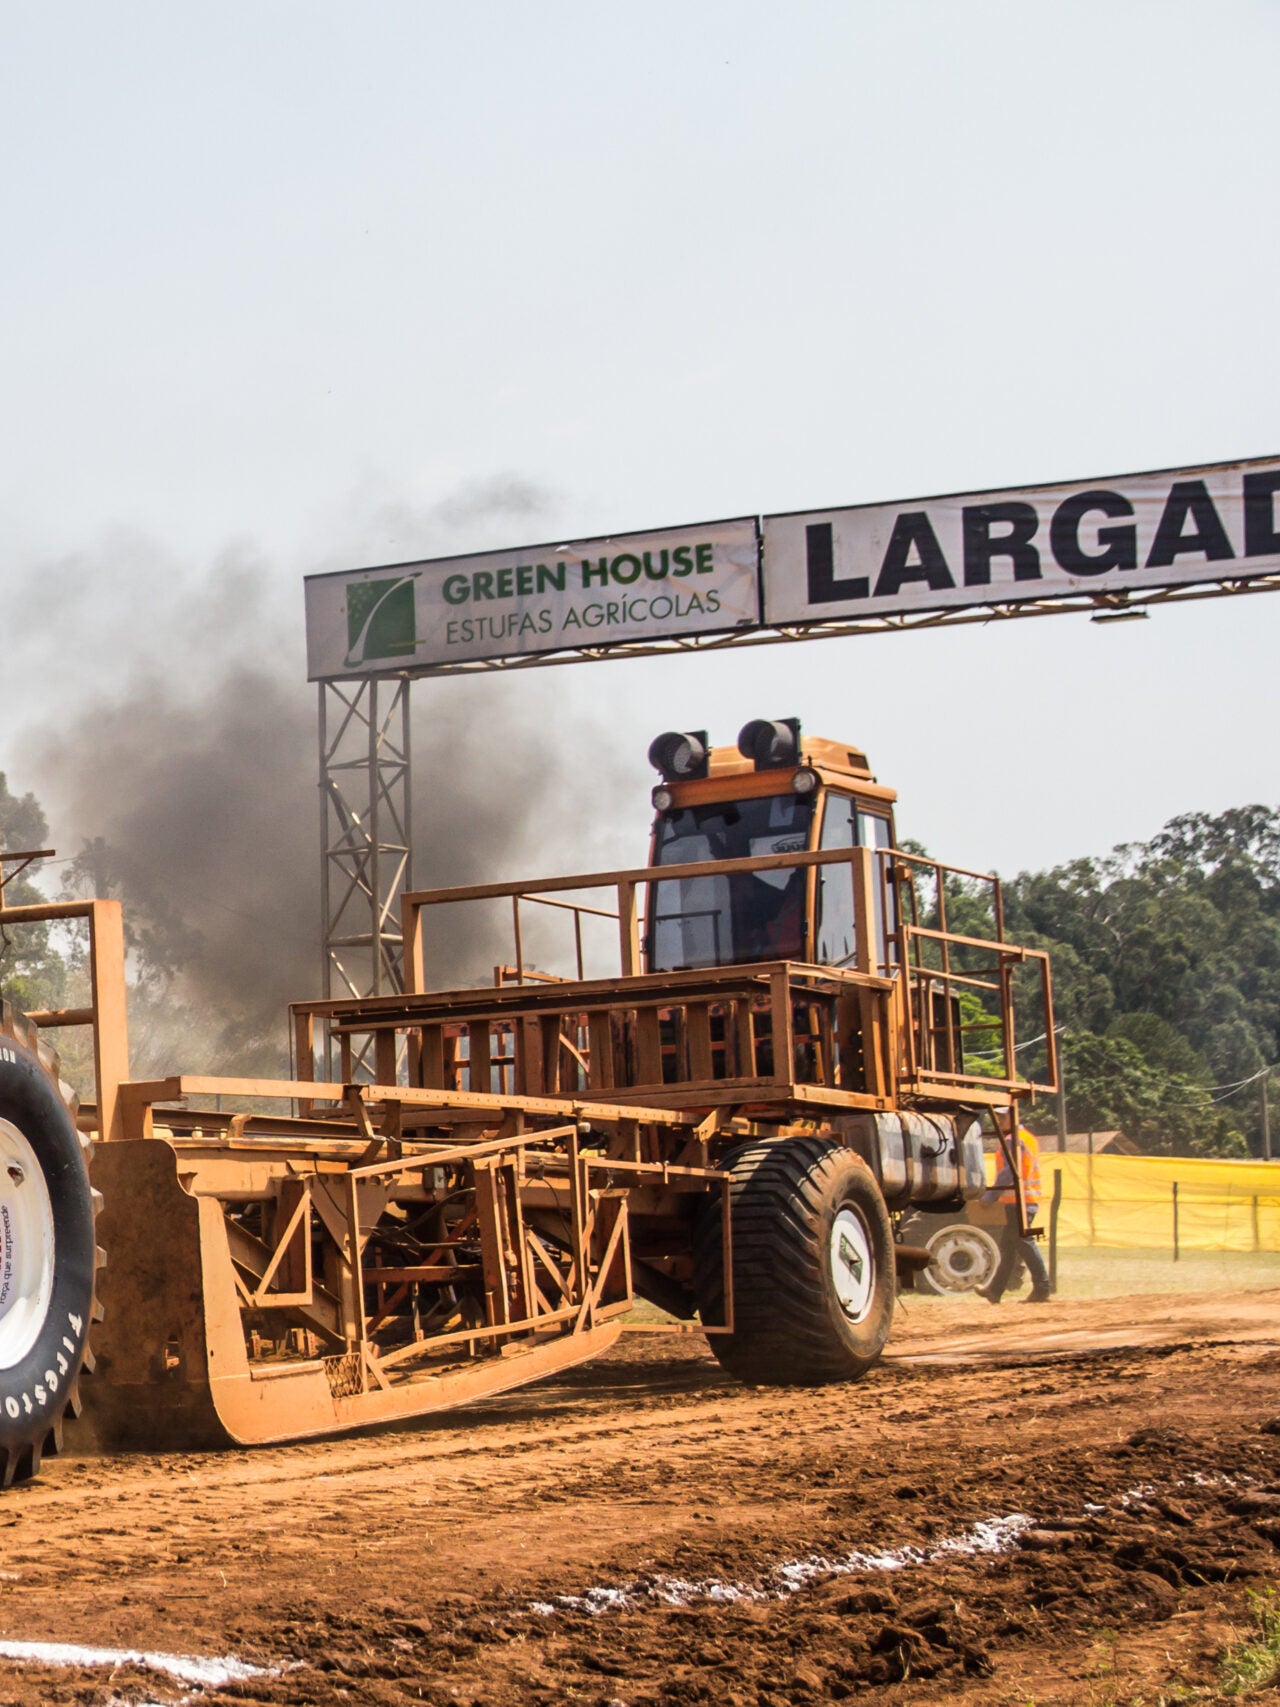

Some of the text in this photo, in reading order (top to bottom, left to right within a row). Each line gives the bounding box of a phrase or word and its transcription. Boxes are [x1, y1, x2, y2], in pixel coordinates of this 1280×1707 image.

[442, 542, 714, 605] GREEN HOUSE
[445, 588, 720, 645] ESTUFAS AGRÍCOLAS
[1, 1205, 13, 1260] surpreende
[4, 1261, 13, 1280] que
